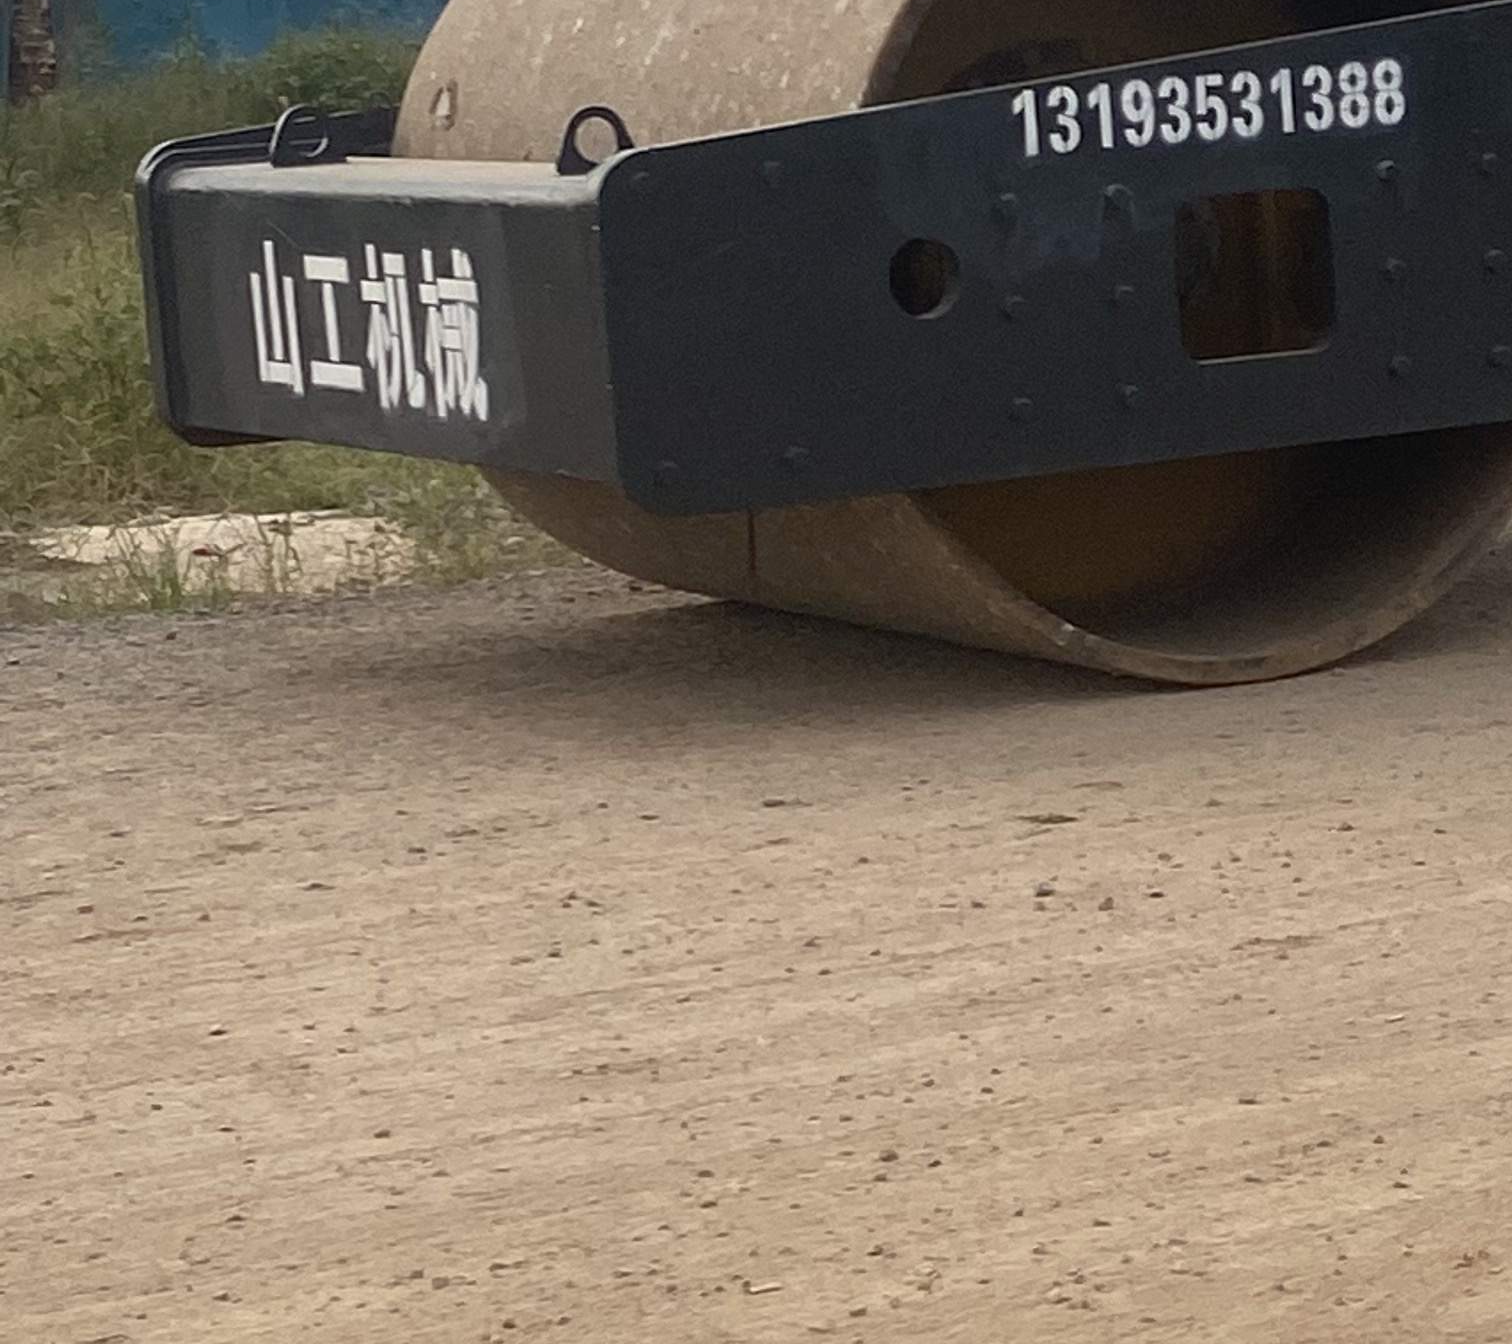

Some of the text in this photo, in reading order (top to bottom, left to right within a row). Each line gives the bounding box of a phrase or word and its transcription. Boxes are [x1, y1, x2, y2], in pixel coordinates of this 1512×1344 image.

[1011, 58, 1406, 157] 13193531388
[249, 240, 489, 422] 山工机械
